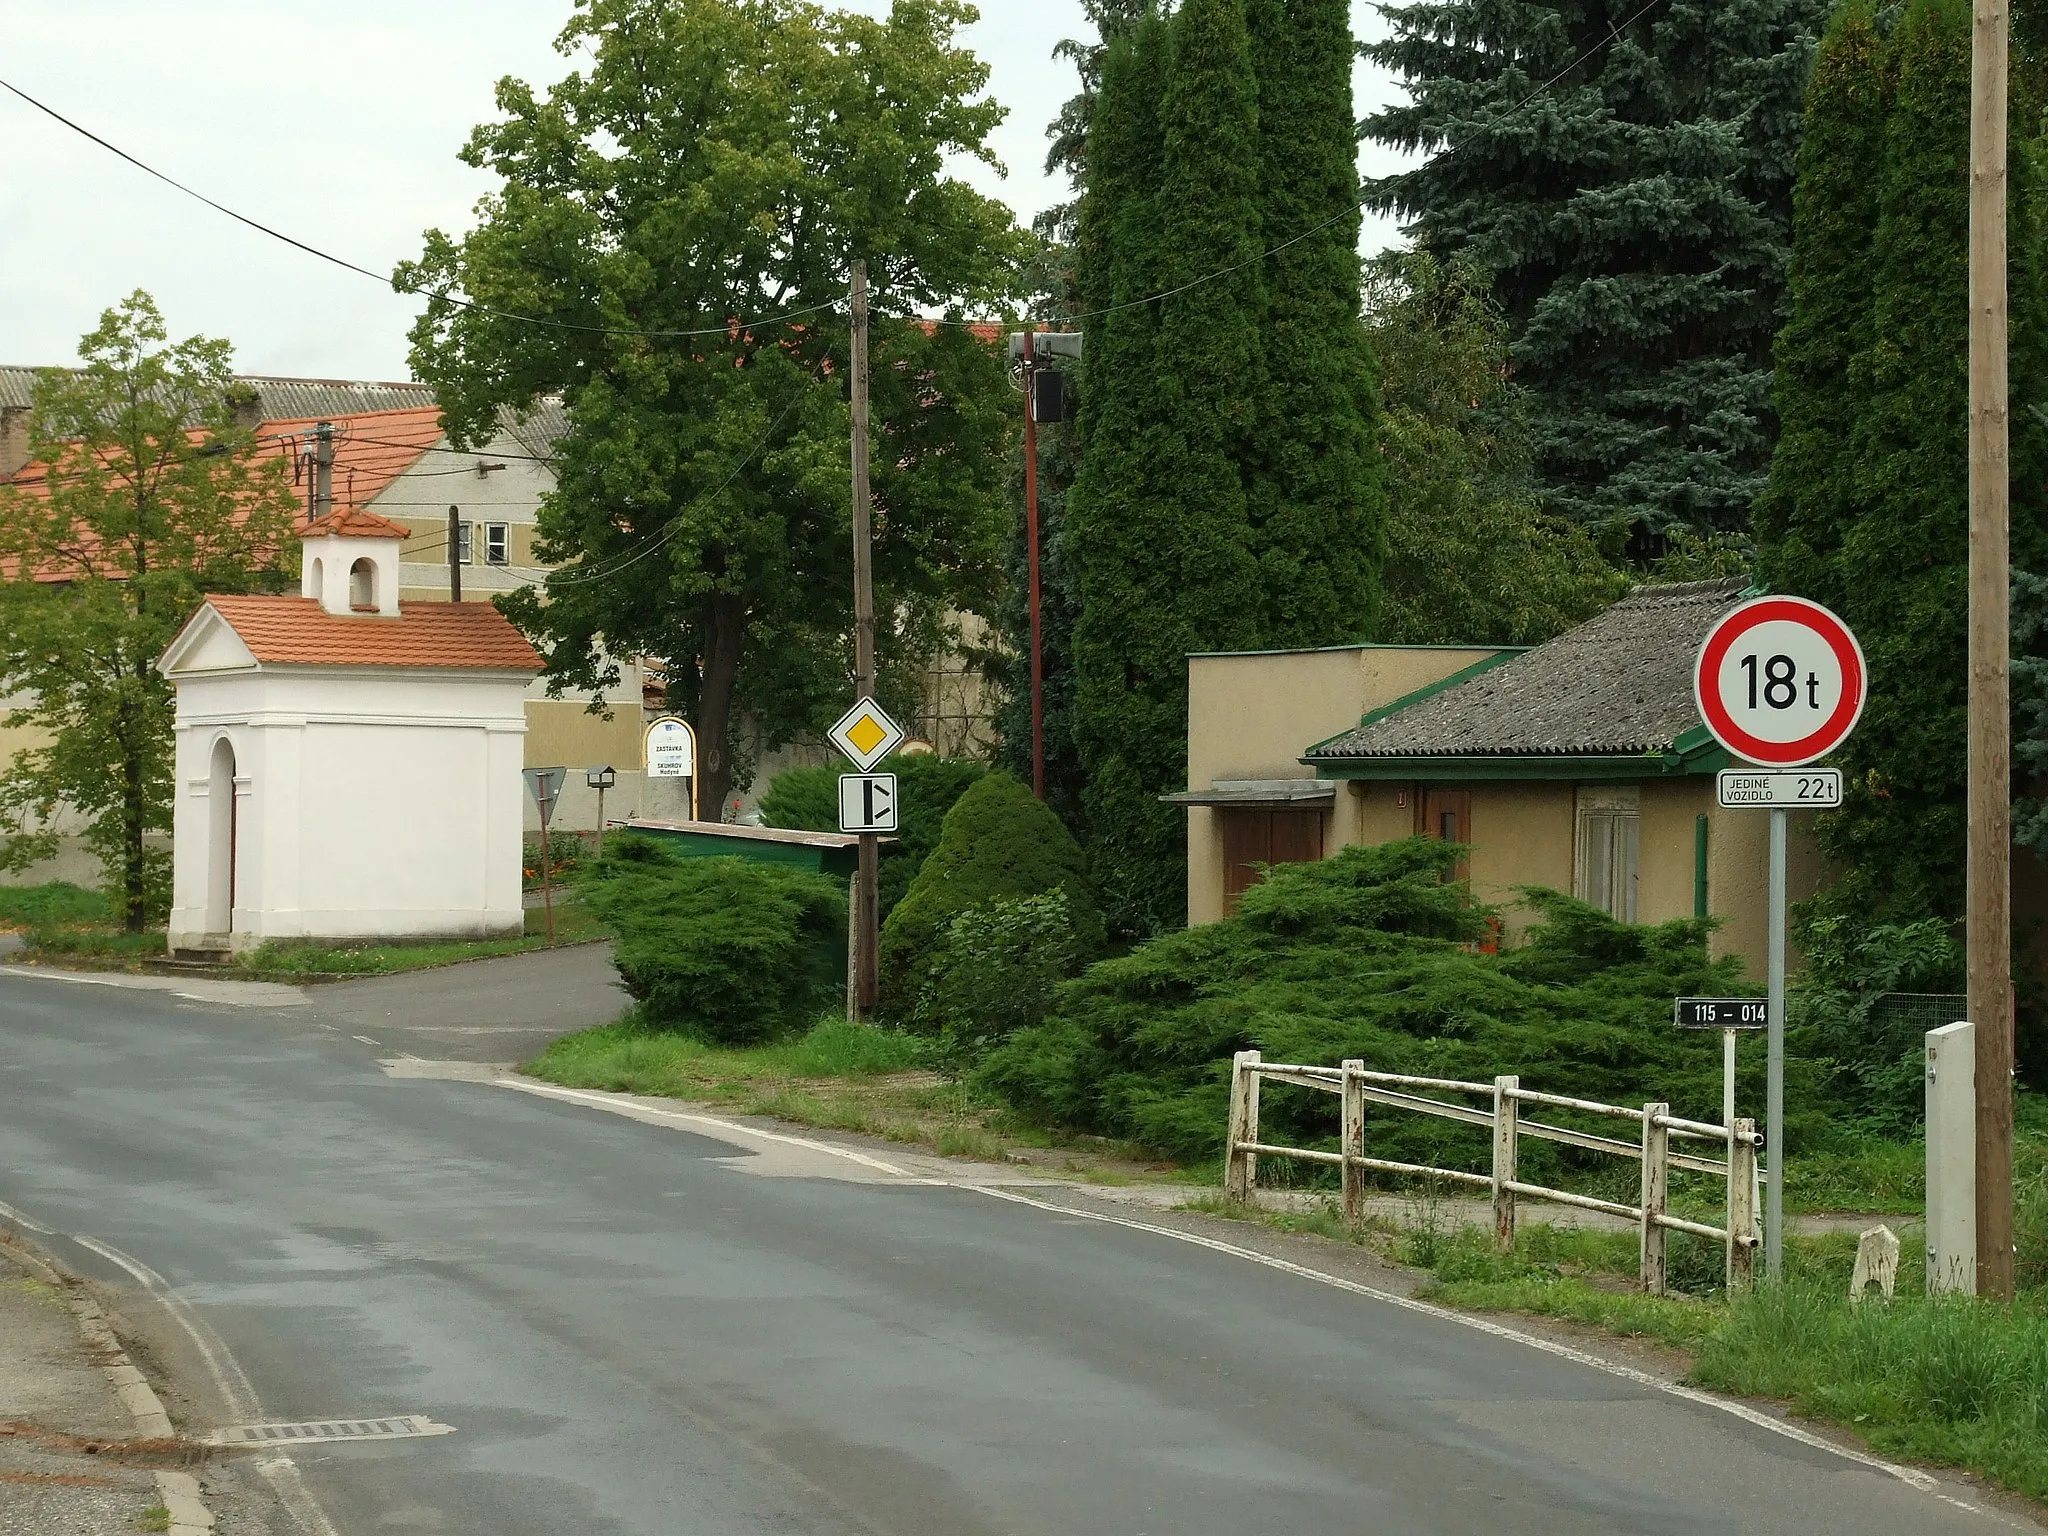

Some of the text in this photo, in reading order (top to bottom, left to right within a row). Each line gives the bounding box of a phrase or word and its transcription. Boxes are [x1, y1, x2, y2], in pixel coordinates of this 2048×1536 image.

[1730, 776, 1770, 789] JEDINÉ
[1726, 791, 1773, 800] VOZIDLO
[1695, 1004, 1716, 1021] 115
[1741, 1004, 1766, 1022] 014
